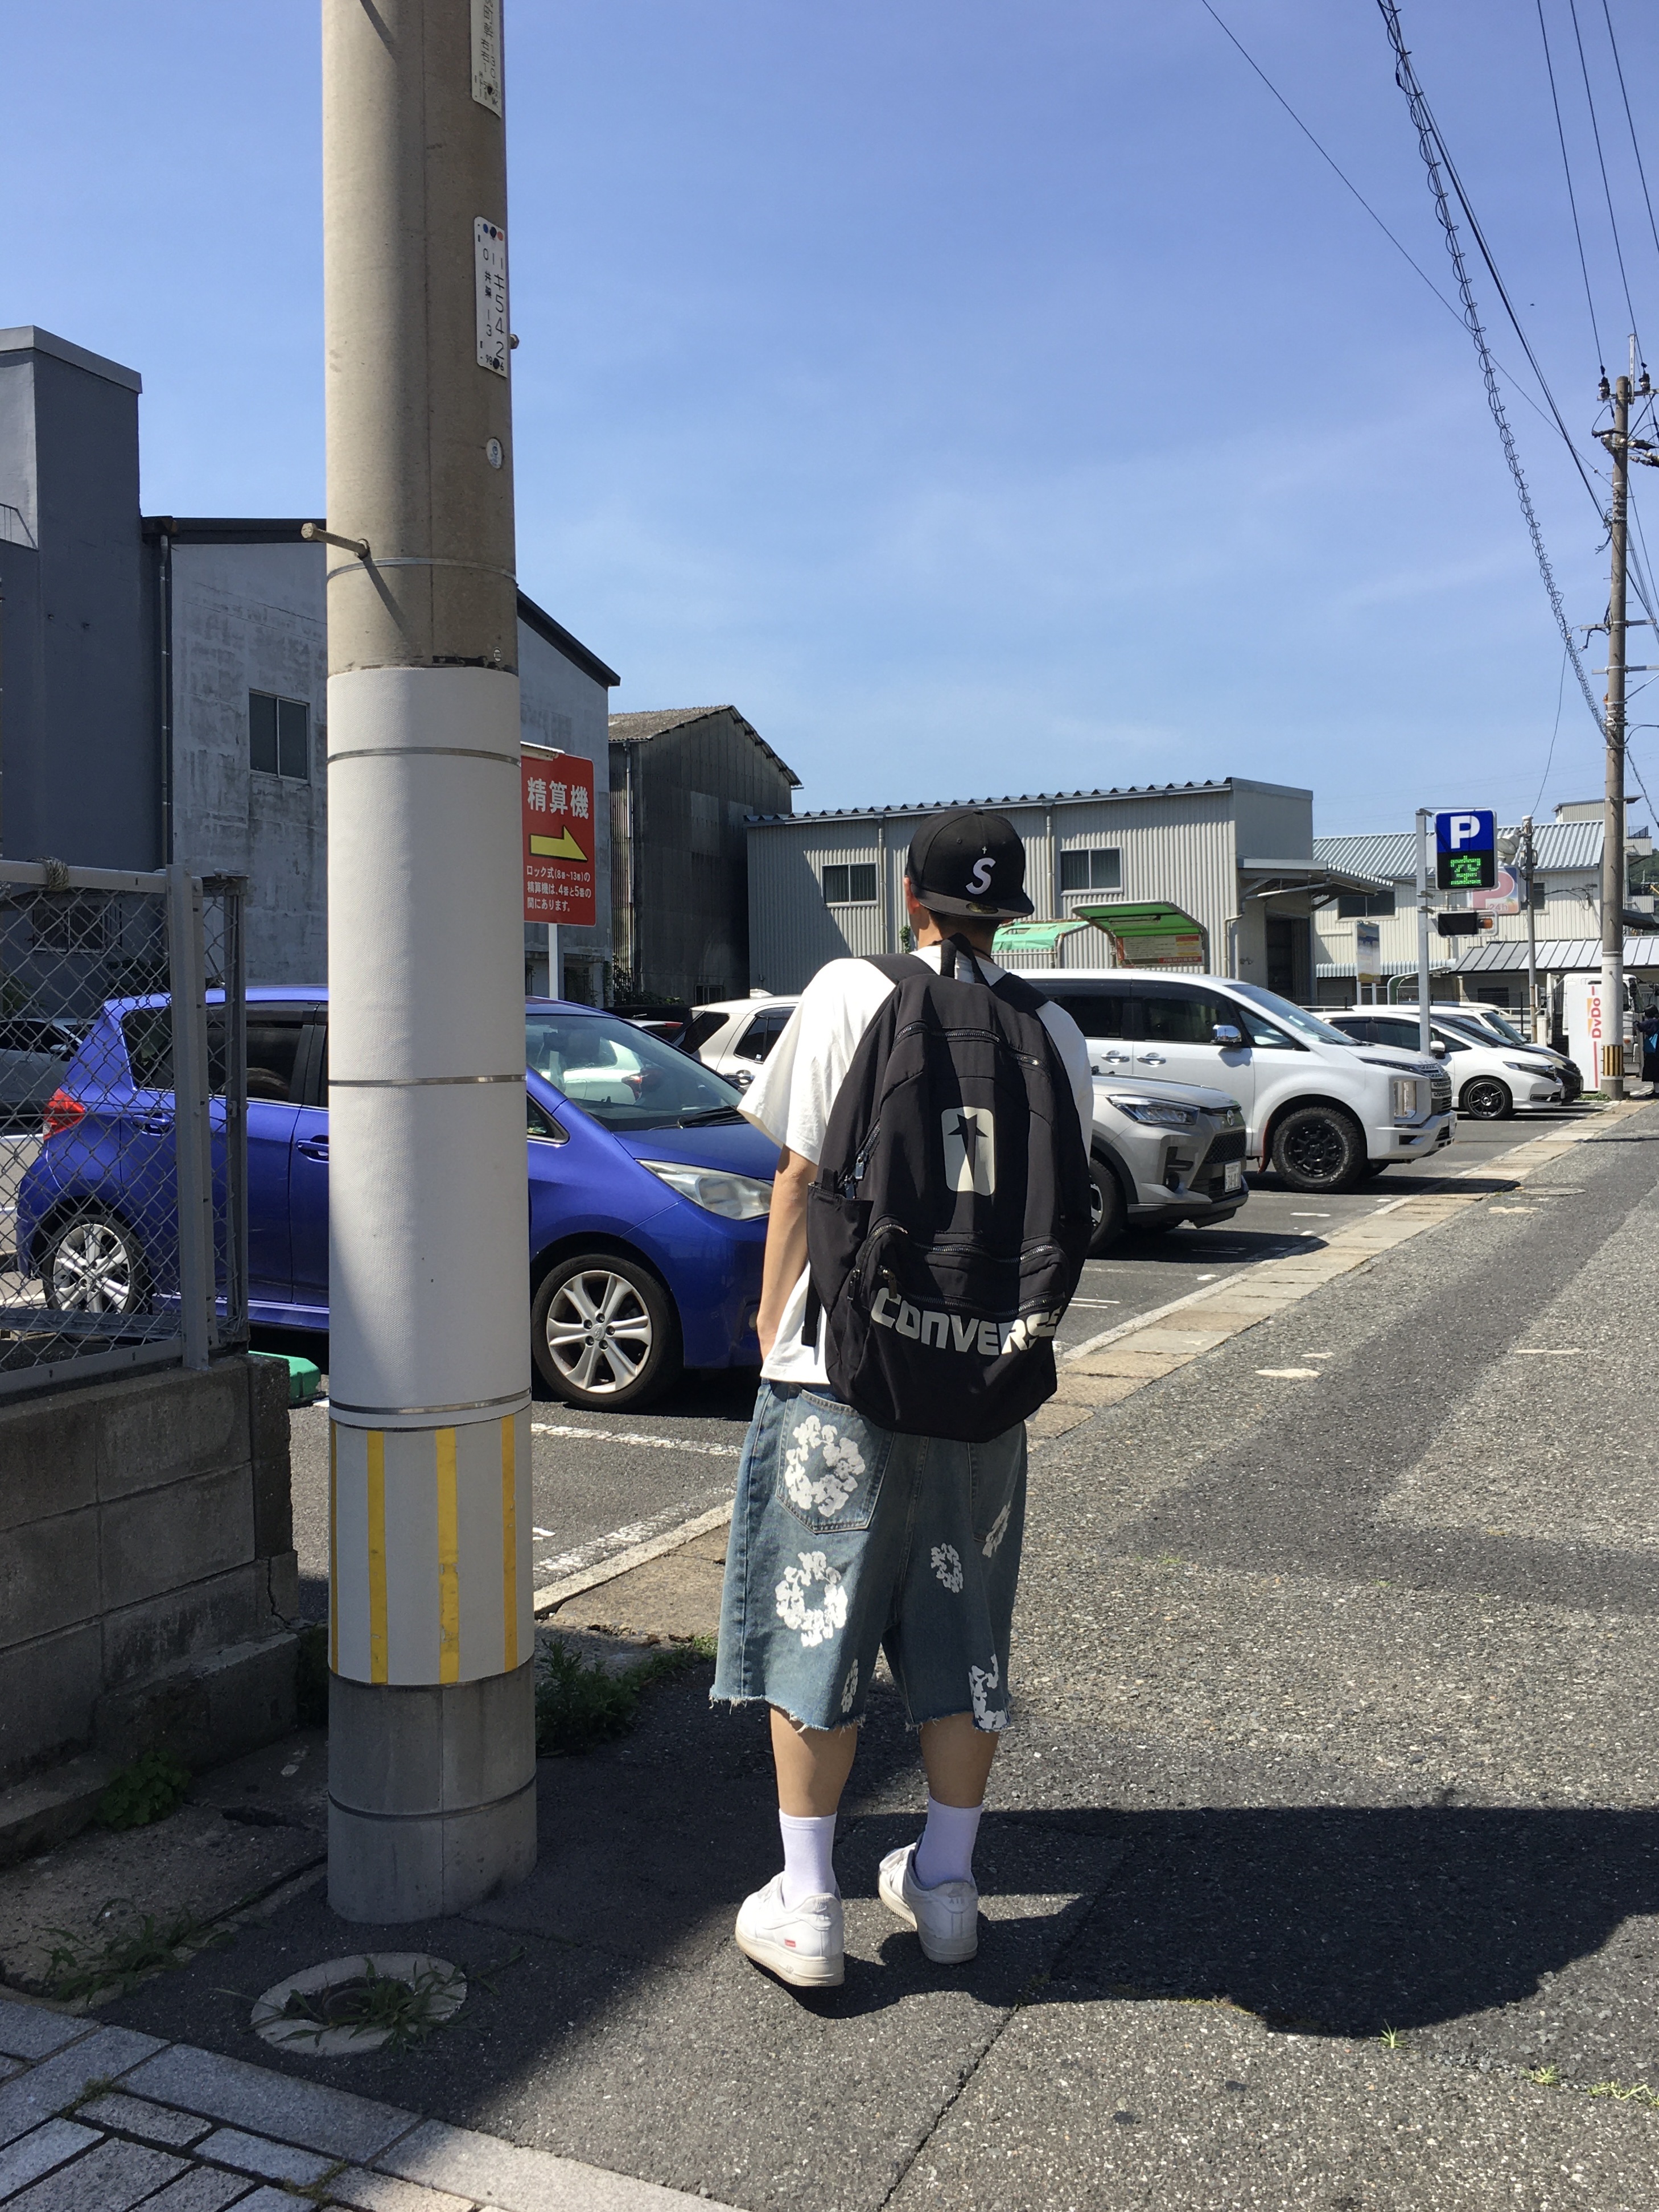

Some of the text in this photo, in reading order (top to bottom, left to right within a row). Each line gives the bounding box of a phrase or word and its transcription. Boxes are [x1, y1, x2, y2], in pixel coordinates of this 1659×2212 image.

[527, 776, 590, 820] 精算機
[1450, 815, 1481, 849] P
[965, 857, 996, 895] S
[1450, 855, 1481, 885] 空
[527, 880, 592, 899] 精算機は、4番と5番の
[527, 897, 570, 912] 間にあります。
[871, 1286, 1061, 1356] CONVERSE
